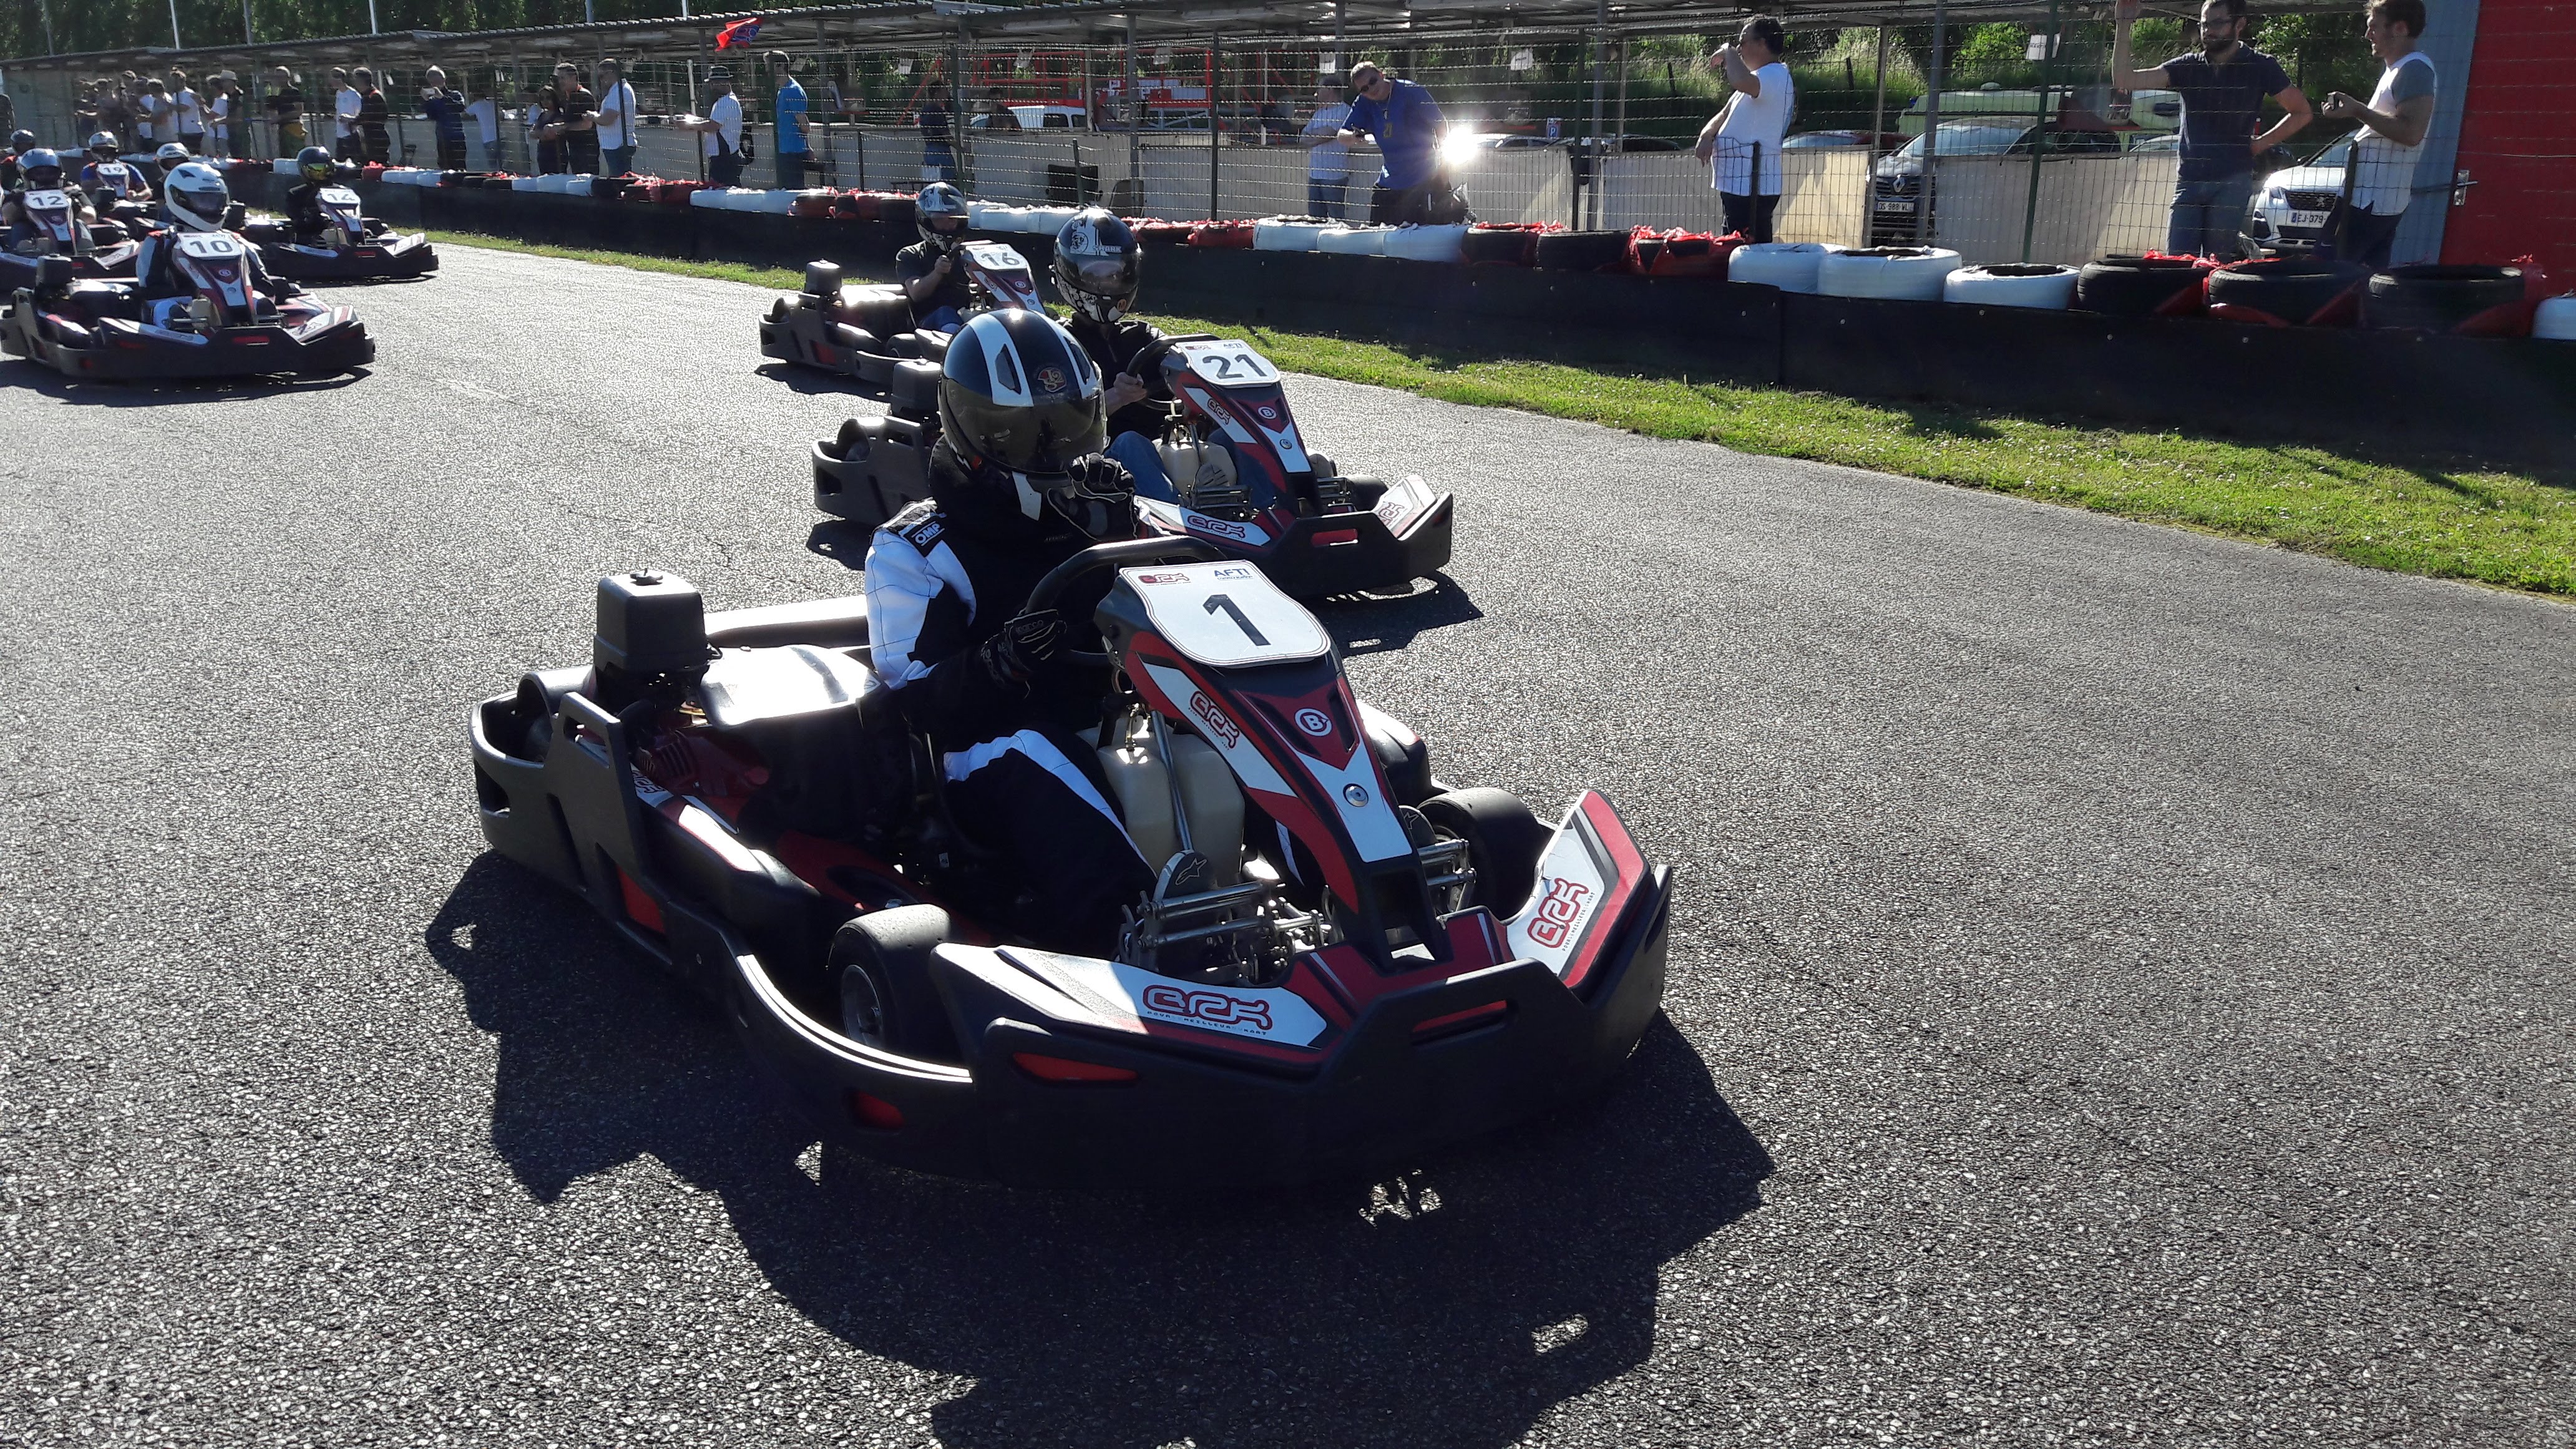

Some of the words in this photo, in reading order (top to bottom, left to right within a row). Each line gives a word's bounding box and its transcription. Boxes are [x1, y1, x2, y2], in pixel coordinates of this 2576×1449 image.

[32, 196, 64, 206] 12
[190, 240, 233, 253] 10
[1093, 245, 1123, 253] SHARK
[980, 252, 1020, 266] 16
[1202, 354, 1268, 379] 21
[915, 523, 940, 544] OMP
[1214, 568, 1251, 577] AFTI
[1203, 593, 1271, 646] 1
